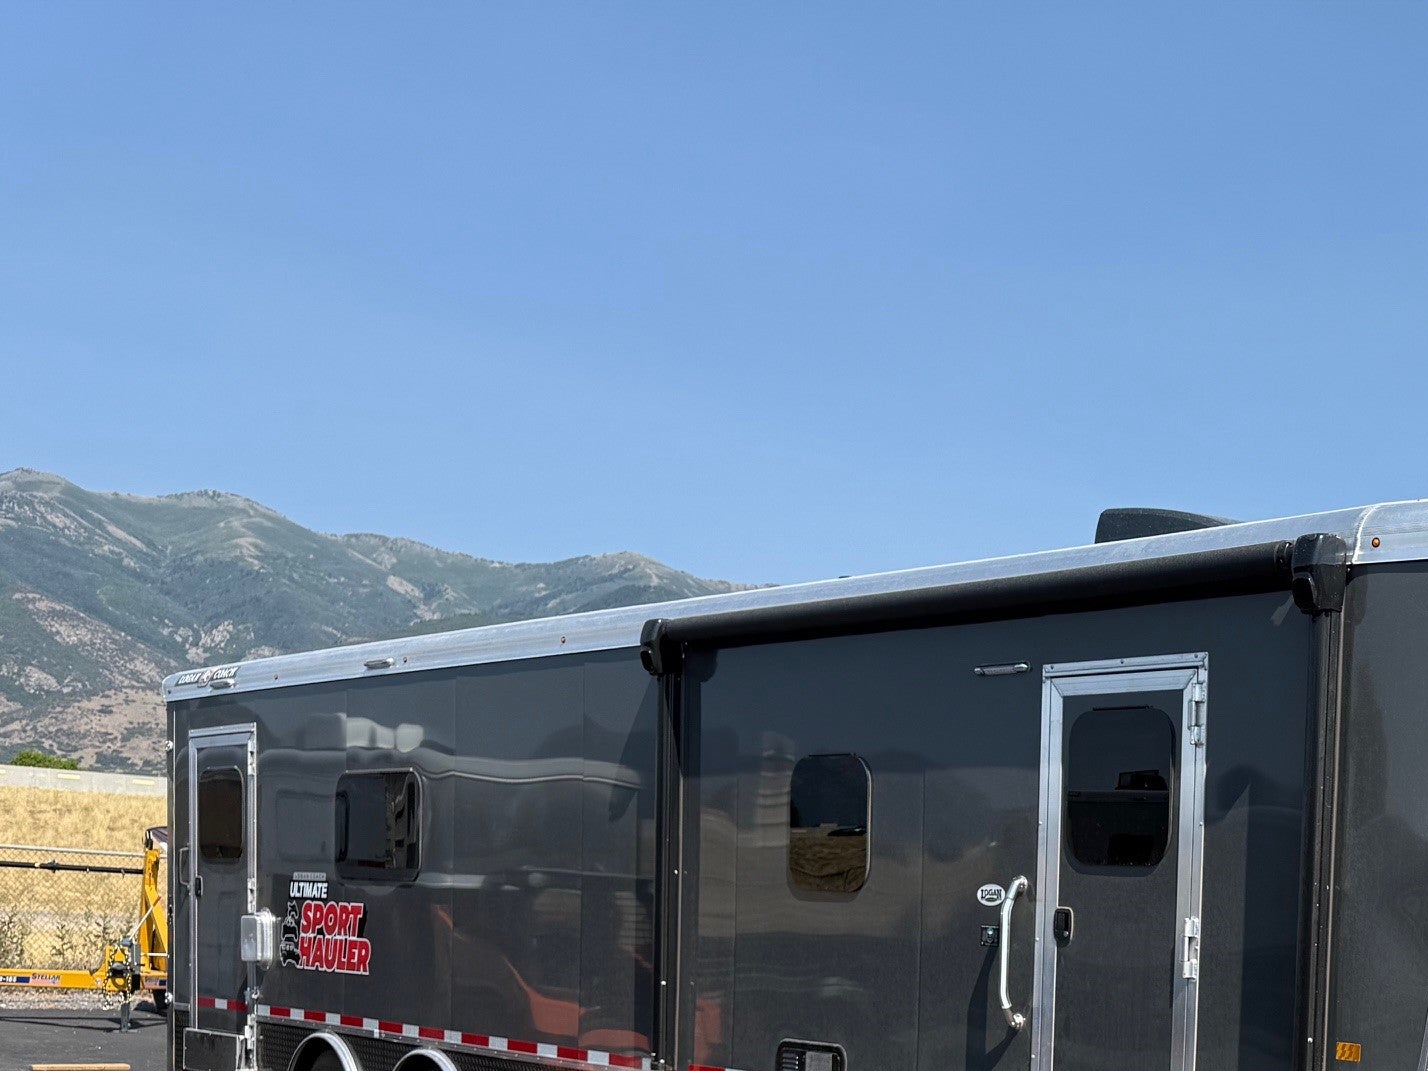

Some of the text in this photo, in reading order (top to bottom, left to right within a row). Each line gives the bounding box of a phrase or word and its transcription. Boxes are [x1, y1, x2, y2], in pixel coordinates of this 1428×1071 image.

[290, 881, 328, 899] ULTIMATE
[981, 889, 1001, 899] LOGAN
[301, 900, 364, 938] SPORT
[299, 935, 372, 976] HAULER
